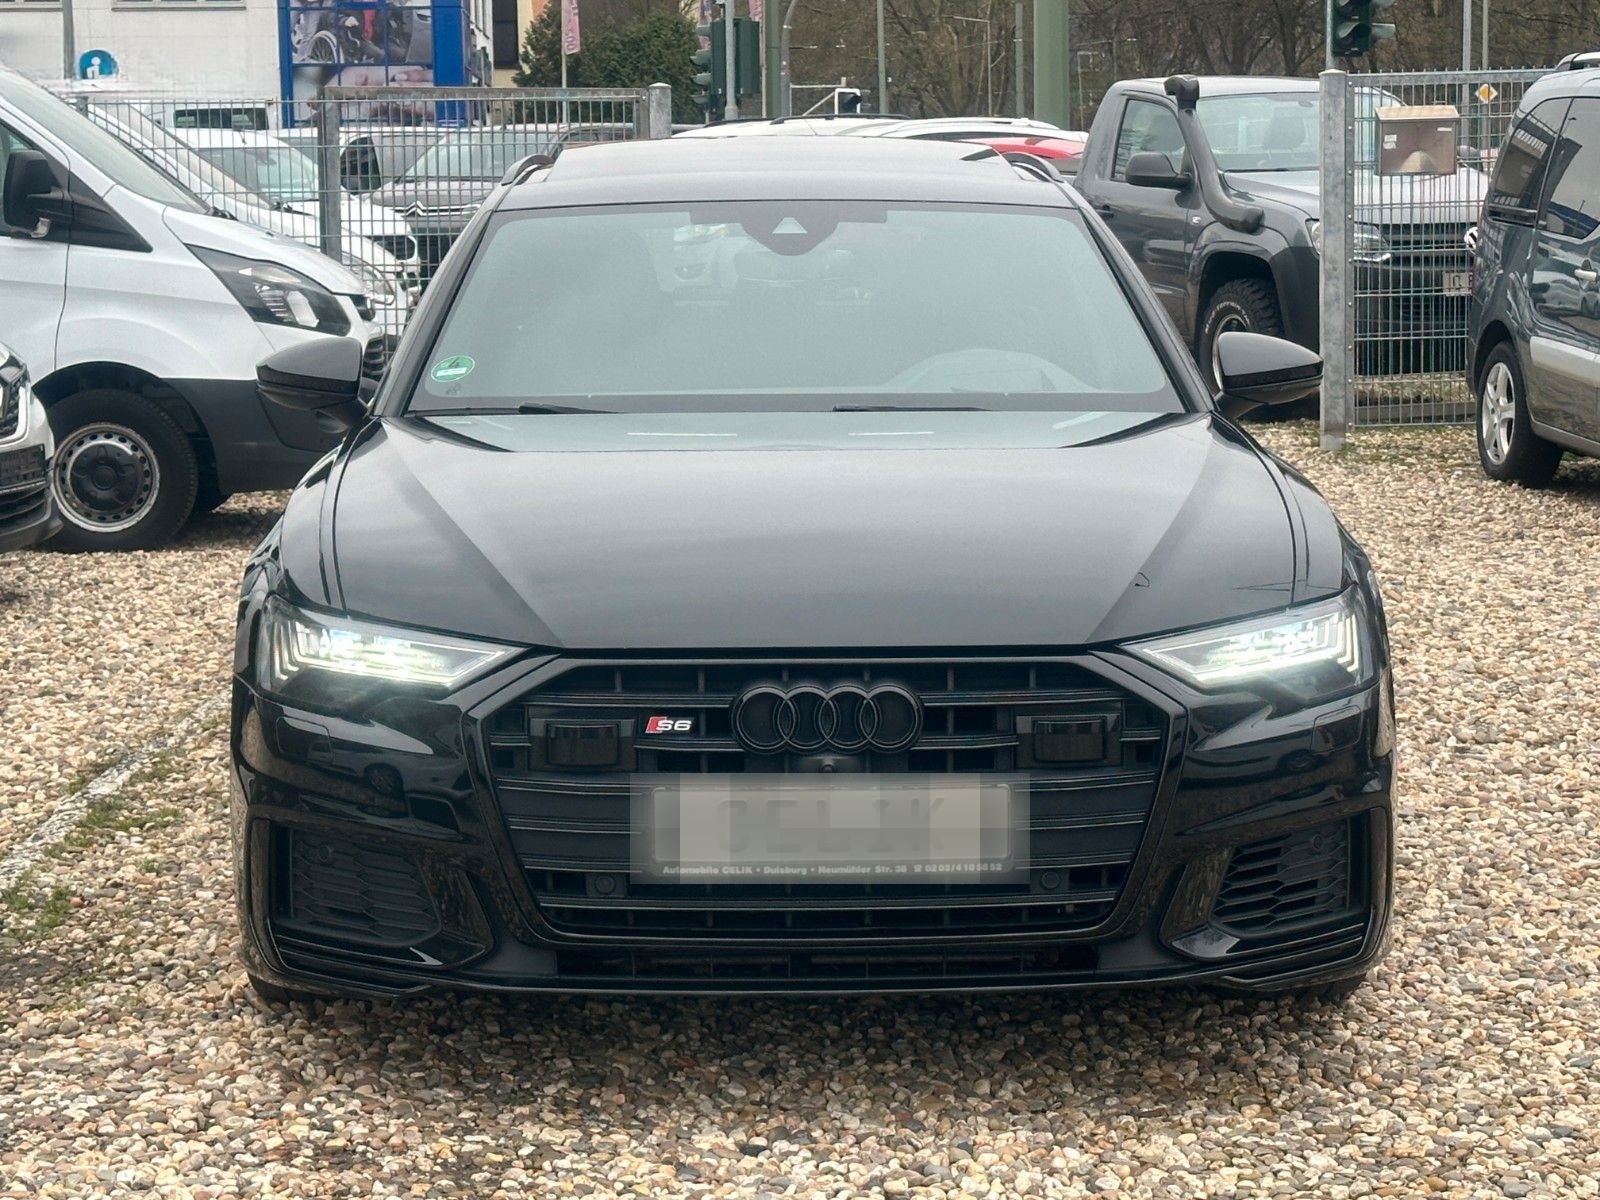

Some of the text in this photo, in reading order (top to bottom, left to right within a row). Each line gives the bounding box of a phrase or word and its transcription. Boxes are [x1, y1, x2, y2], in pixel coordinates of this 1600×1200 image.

[655, 719, 693, 731] S6
[662, 865, 719, 874] Automobile
[721, 865, 754, 874] CELIK
[763, 865, 808, 876] Duisburg
[874, 864, 893, 874] Str.
